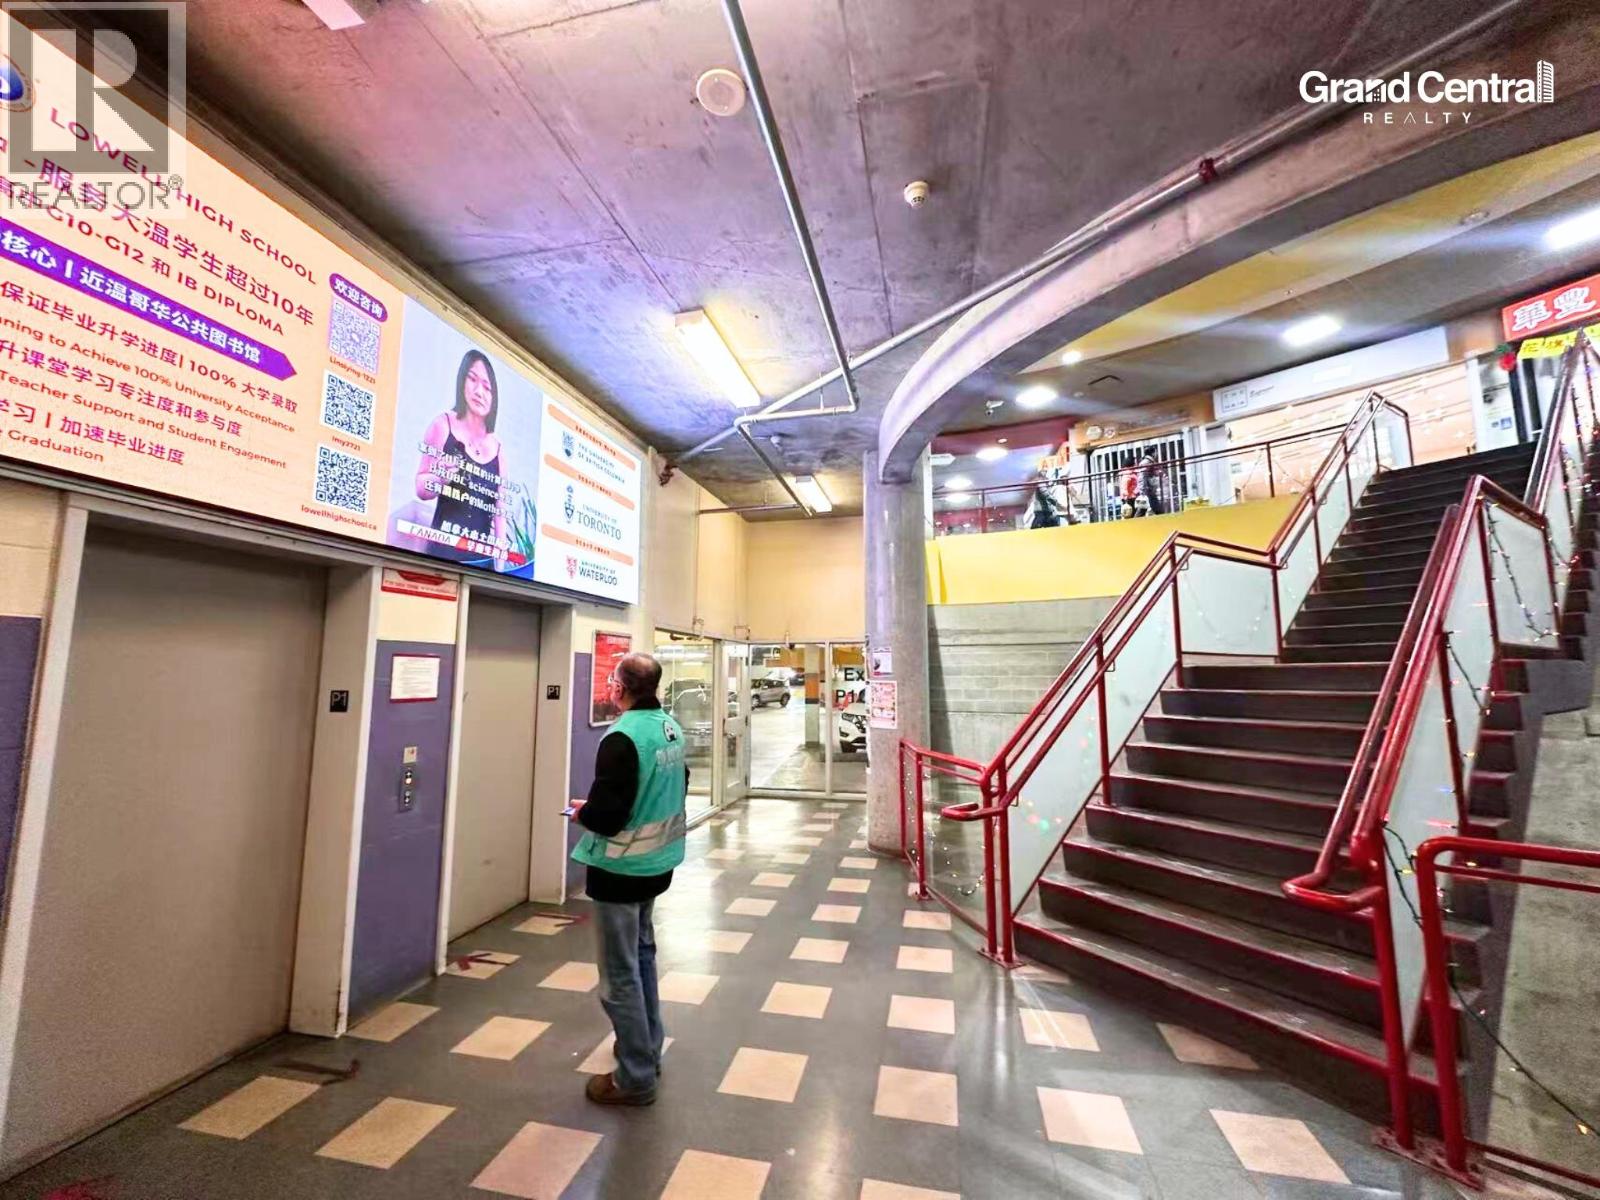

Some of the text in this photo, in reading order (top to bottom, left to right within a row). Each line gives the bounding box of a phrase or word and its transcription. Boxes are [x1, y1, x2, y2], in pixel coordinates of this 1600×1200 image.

[176, 186, 234, 233] HIGH
[240, 228, 317, 285] SCHOOL
[46, 204, 144, 264] G10-G12
[151, 256, 170, 278] 和
[177, 271, 198, 291] IB
[204, 285, 284, 336] DIPLOMA
[49, 333, 66, 348] to
[70, 343, 131, 371] Achieve
[134, 365, 172, 388] 100%
[174, 381, 233, 411] University
[235, 405, 295, 433] Acceptance
[190, 359, 237, 389] 100%
[241, 382, 298, 414] 大学录取
[0, 369, 287, 469] Teacher Support and Student Engagement
[8, 429, 104, 462] Graduation
[60, 416, 185, 465] 加速毕业进度
[577, 511, 621, 540] TORONTO
[579, 566, 617, 586] WATERLOO
[547, 686, 559, 696] P1
[844, 667, 866, 681] Ex
[331, 692, 347, 706] P1
